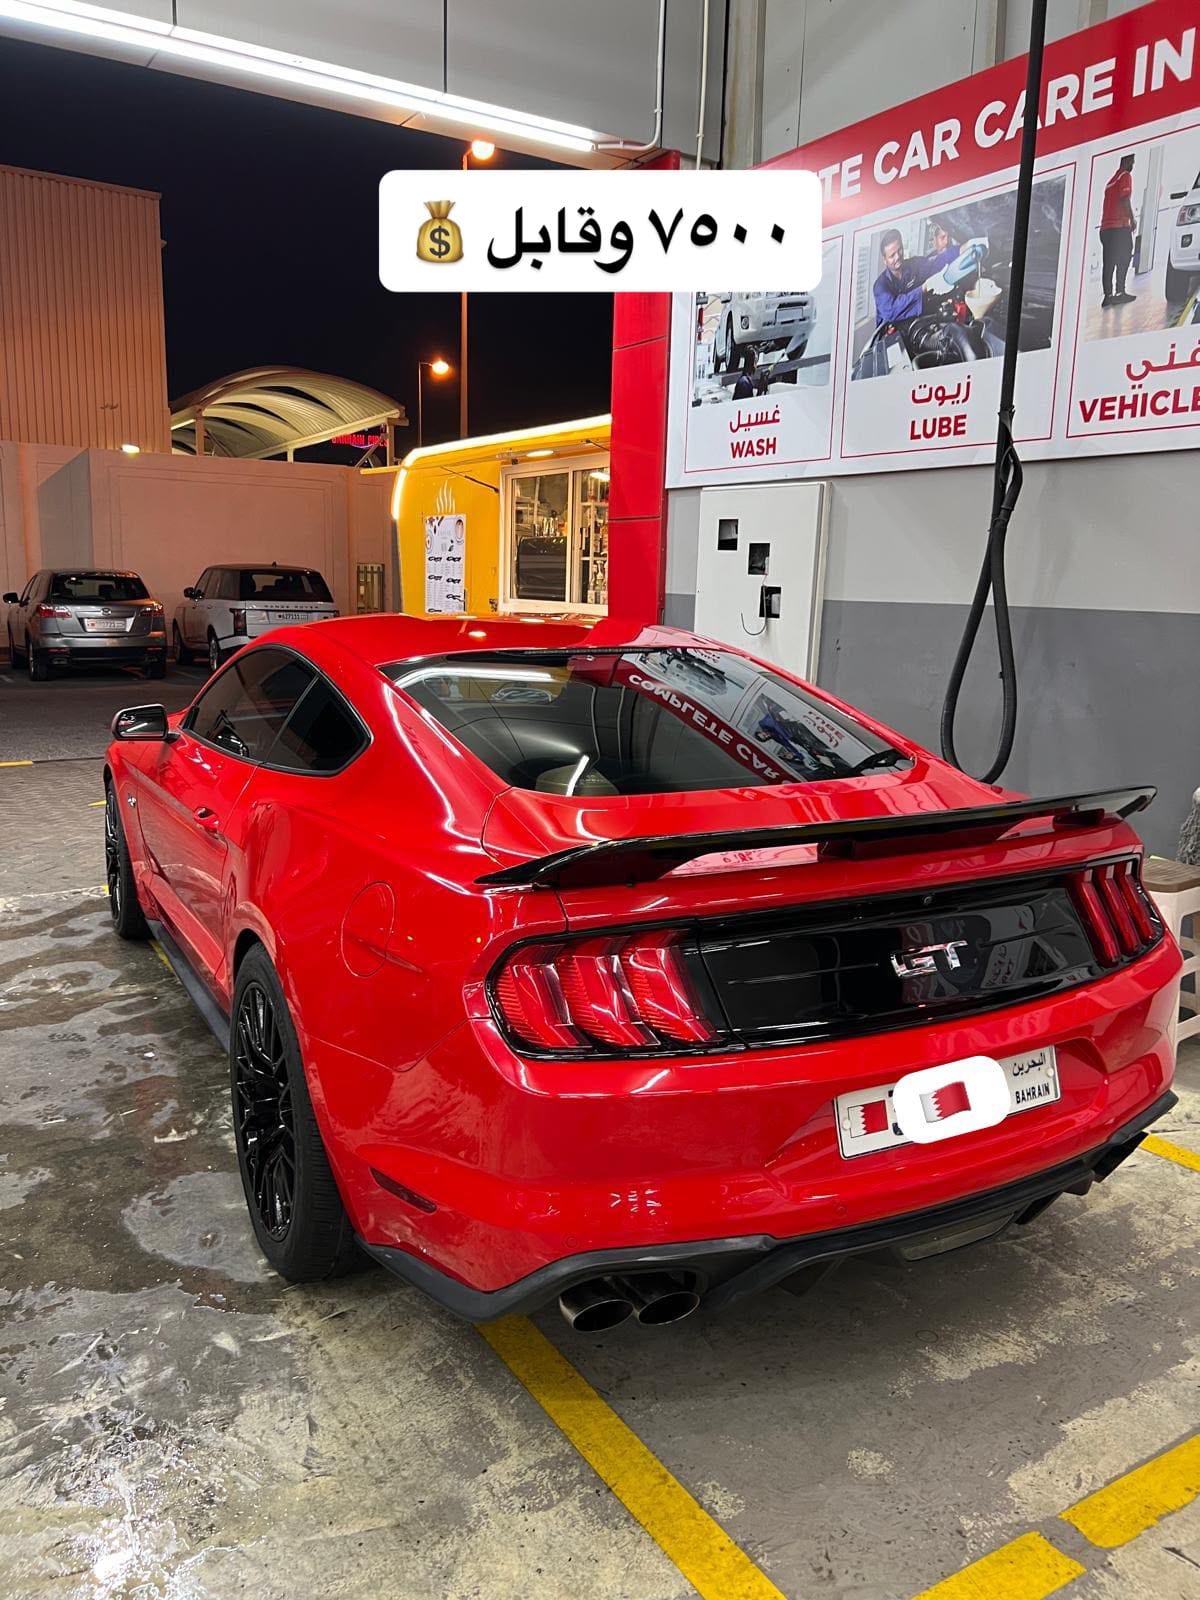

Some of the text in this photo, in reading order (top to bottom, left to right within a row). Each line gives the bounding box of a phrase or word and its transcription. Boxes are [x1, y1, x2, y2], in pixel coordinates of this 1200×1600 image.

[873, 118, 962, 184] CAR
[974, 57, 1117, 148] CARE
[1133, 28, 1197, 97] IN
[911, 375, 972, 407] زيوت
[729, 404, 781, 433] غسيل
[909, 414, 967, 440] LUBE
[730, 436, 777, 459] WASH
[890, 940, 968, 978] GT
[1012, 1053, 1047, 1077] البحرين
[1015, 1082, 1050, 1104] BAHRAIN
